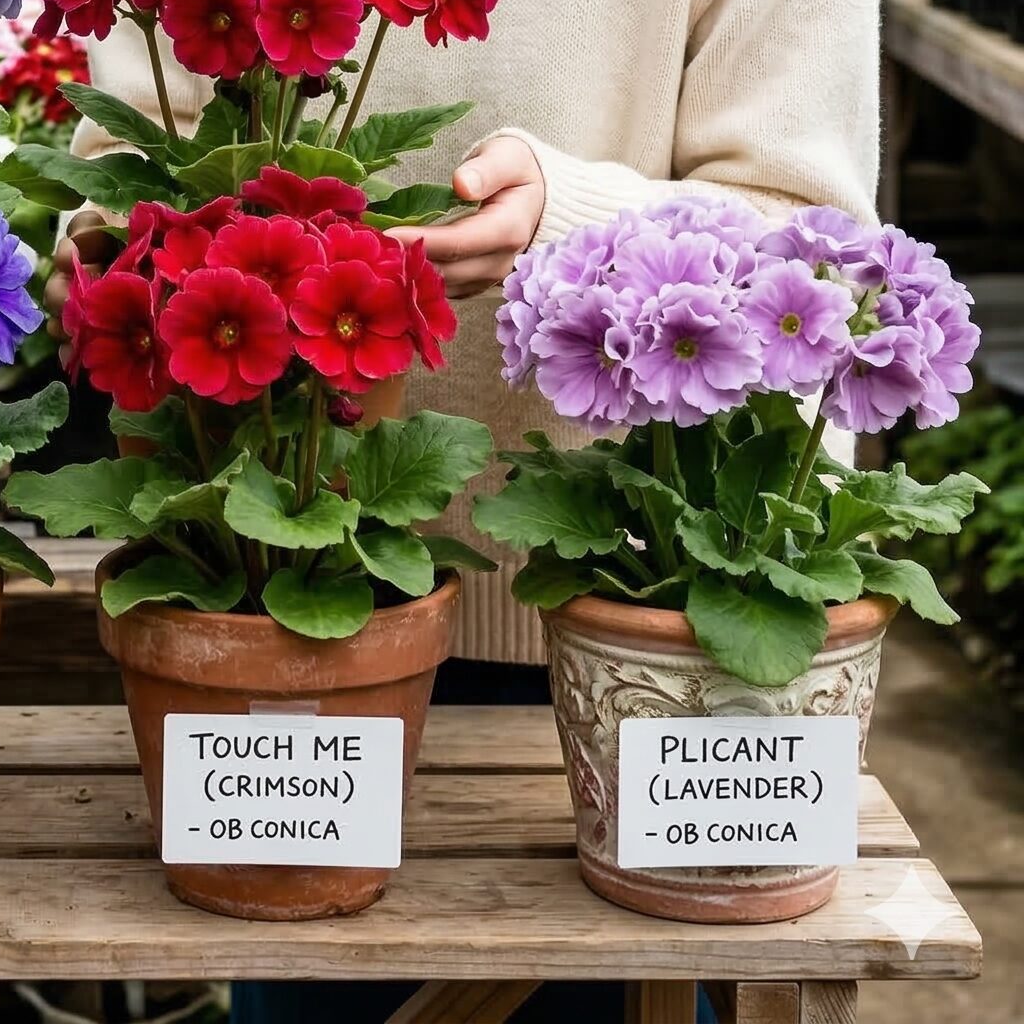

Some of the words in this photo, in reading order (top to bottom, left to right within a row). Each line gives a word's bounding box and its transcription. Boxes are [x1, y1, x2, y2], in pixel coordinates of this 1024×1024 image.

[188, 732, 293, 761] TOUCH
[313, 735, 362, 762] ME
[661, 735, 804, 765] PLICANT
[204, 769, 355, 804] (CRIMSON)
[648, 770, 823, 806] (LAVENDER)
